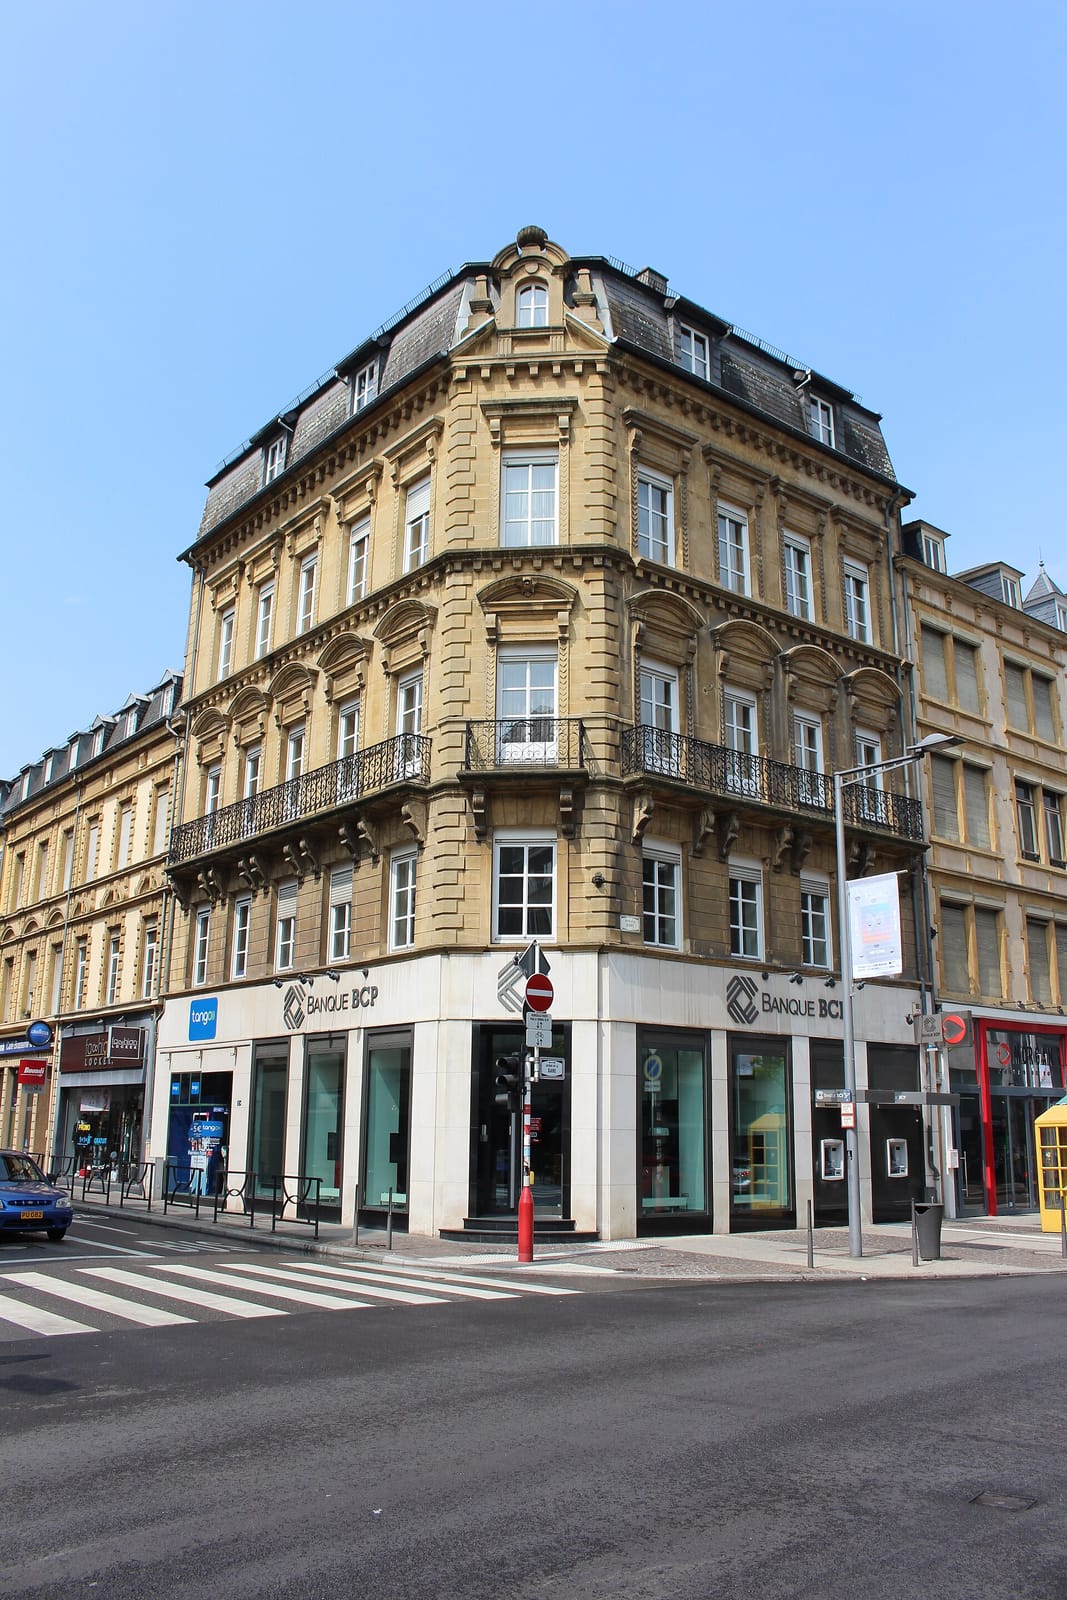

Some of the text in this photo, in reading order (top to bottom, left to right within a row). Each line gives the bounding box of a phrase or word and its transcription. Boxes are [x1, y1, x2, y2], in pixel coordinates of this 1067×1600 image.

[307, 985, 379, 1014] BANQUE BCP
[762, 993, 816, 1017] BANQUE
[192, 1009, 214, 1026] tango
[202, 1124, 221, 1133] tango
